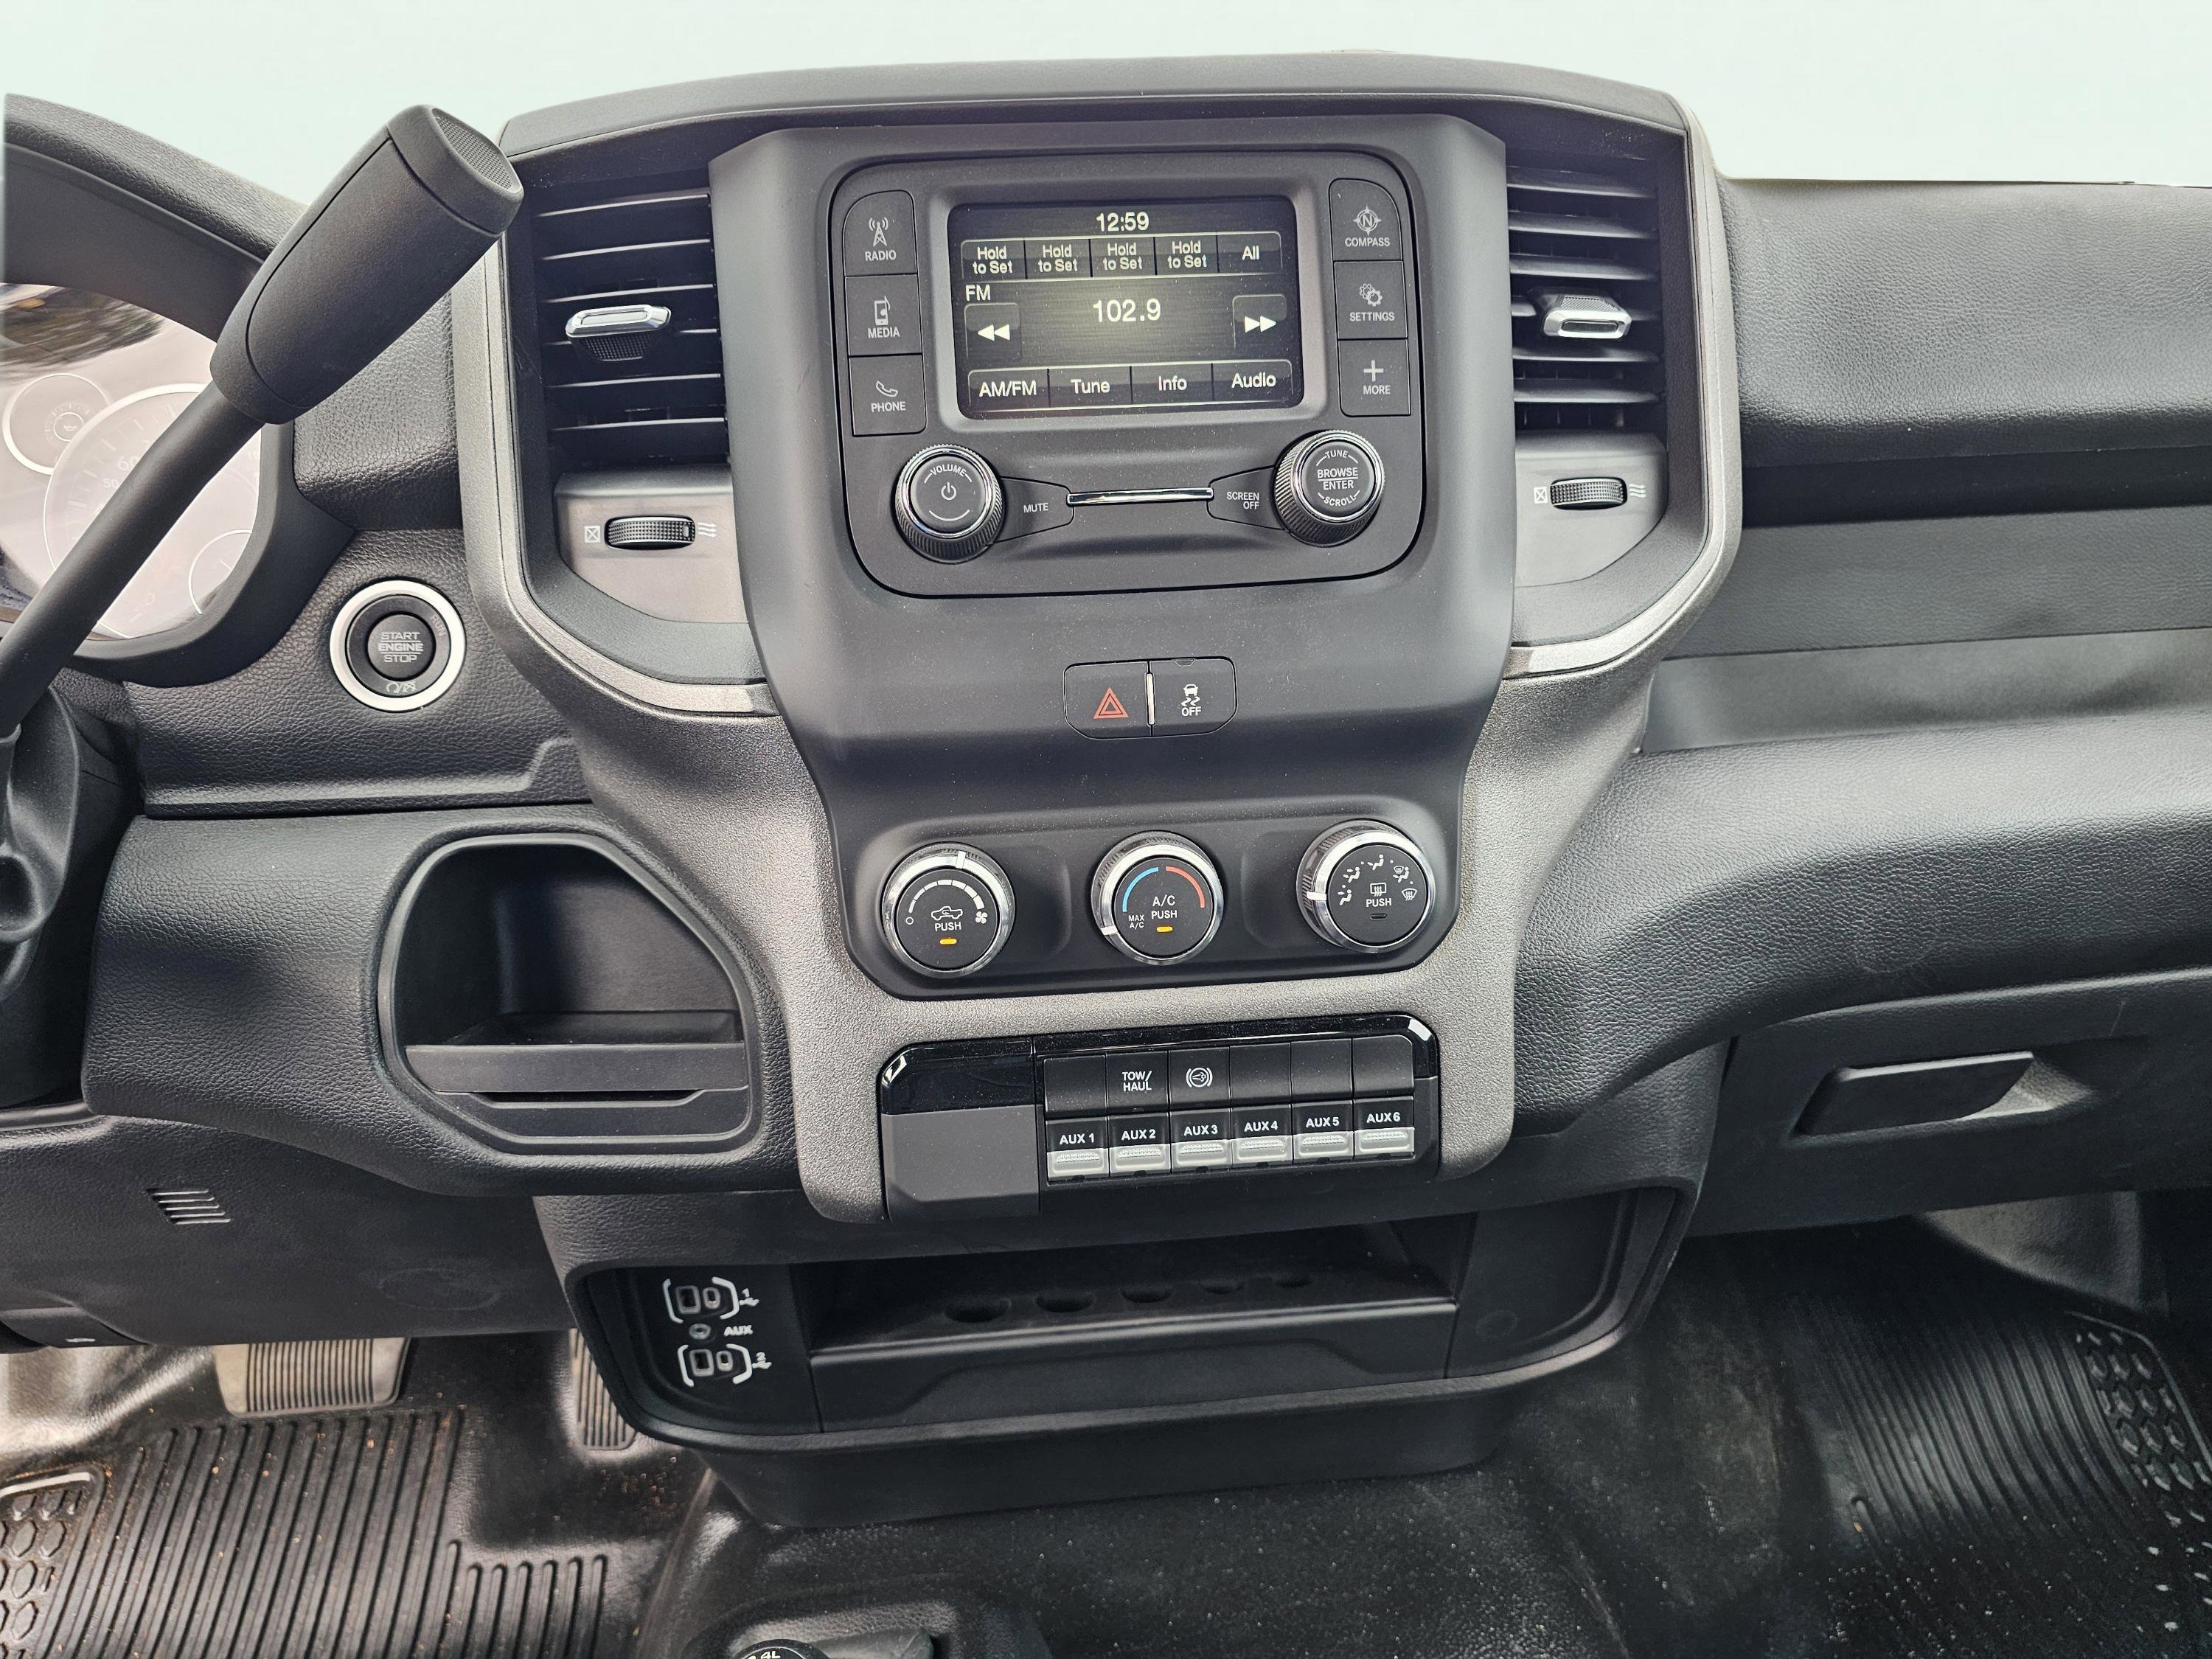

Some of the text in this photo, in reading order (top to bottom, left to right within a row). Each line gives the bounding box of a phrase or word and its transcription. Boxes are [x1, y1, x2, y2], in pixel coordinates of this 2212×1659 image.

[1096, 212, 1150, 232] 12:59
[1172, 240, 1201, 254] Hold
[1345, 237, 1391, 247] COMPASS
[865, 250, 897, 261] RADIO
[977, 245, 1007, 260] Hold
[1042, 244, 1072, 258] Hold
[1107, 242, 1137, 257] Hold
[1241, 245, 1260, 260] All
[972, 260, 1013, 274] to Set
[1038, 258, 1078, 273] to Set
[1103, 257, 1143, 271] to Set
[1167, 254, 1207, 268] to Set
[965, 284, 991, 301] FM
[1093, 298, 1161, 323] 102.9
[1349, 311, 1395, 321] SETTINGS
[867, 327, 900, 338] MEDIA
[1070, 378, 1110, 394] Tune
[1158, 375, 1188, 392] Info
[1231, 372, 1277, 389] Audio
[978, 380, 1037, 397] AM/FM
[1363, 385, 1391, 395] MORE
[871, 401, 906, 413] PHONE
[1324, 449, 1349, 459] TUNE
[930, 464, 967, 477] VOLUME
[1317, 467, 1359, 479] BROWSE
[1323, 480, 1354, 490] ENTER
[1227, 492, 1259, 501] SCREEN
[1323, 494, 1357, 507] SCROLL
[1023, 502, 1049, 514] MUTE
[1243, 501, 1259, 510] OFF
[429, 614, 447, 636] RUN
[381, 631, 421, 640] START
[378, 642, 424, 652] ENGINE
[383, 654, 417, 663] STOP
[1181, 706, 1202, 717] OFF
[1152, 894, 1176, 907] A/C
[1366, 898, 1392, 908] PUSH
[1128, 914, 1145, 922] MAX
[1151, 910, 1178, 919] PUSH
[934, 921, 962, 932] PUSH
[1129, 922, 1144, 930] A/C
[1121, 1070, 1152, 1081] TOW/
[1123, 1081, 1152, 1092] HAUL
[1305, 1116, 1340, 1128] AUX 5
[1366, 1111, 1401, 1123] AUX 6
[1183, 1124, 1218, 1136] AUX 3
[1244, 1120, 1279, 1132] AUX 4
[1059, 1133, 1095, 1145] AUX 1
[1121, 1128, 1156, 1141] AUX 2
[723, 1324, 754, 1337] AUX
